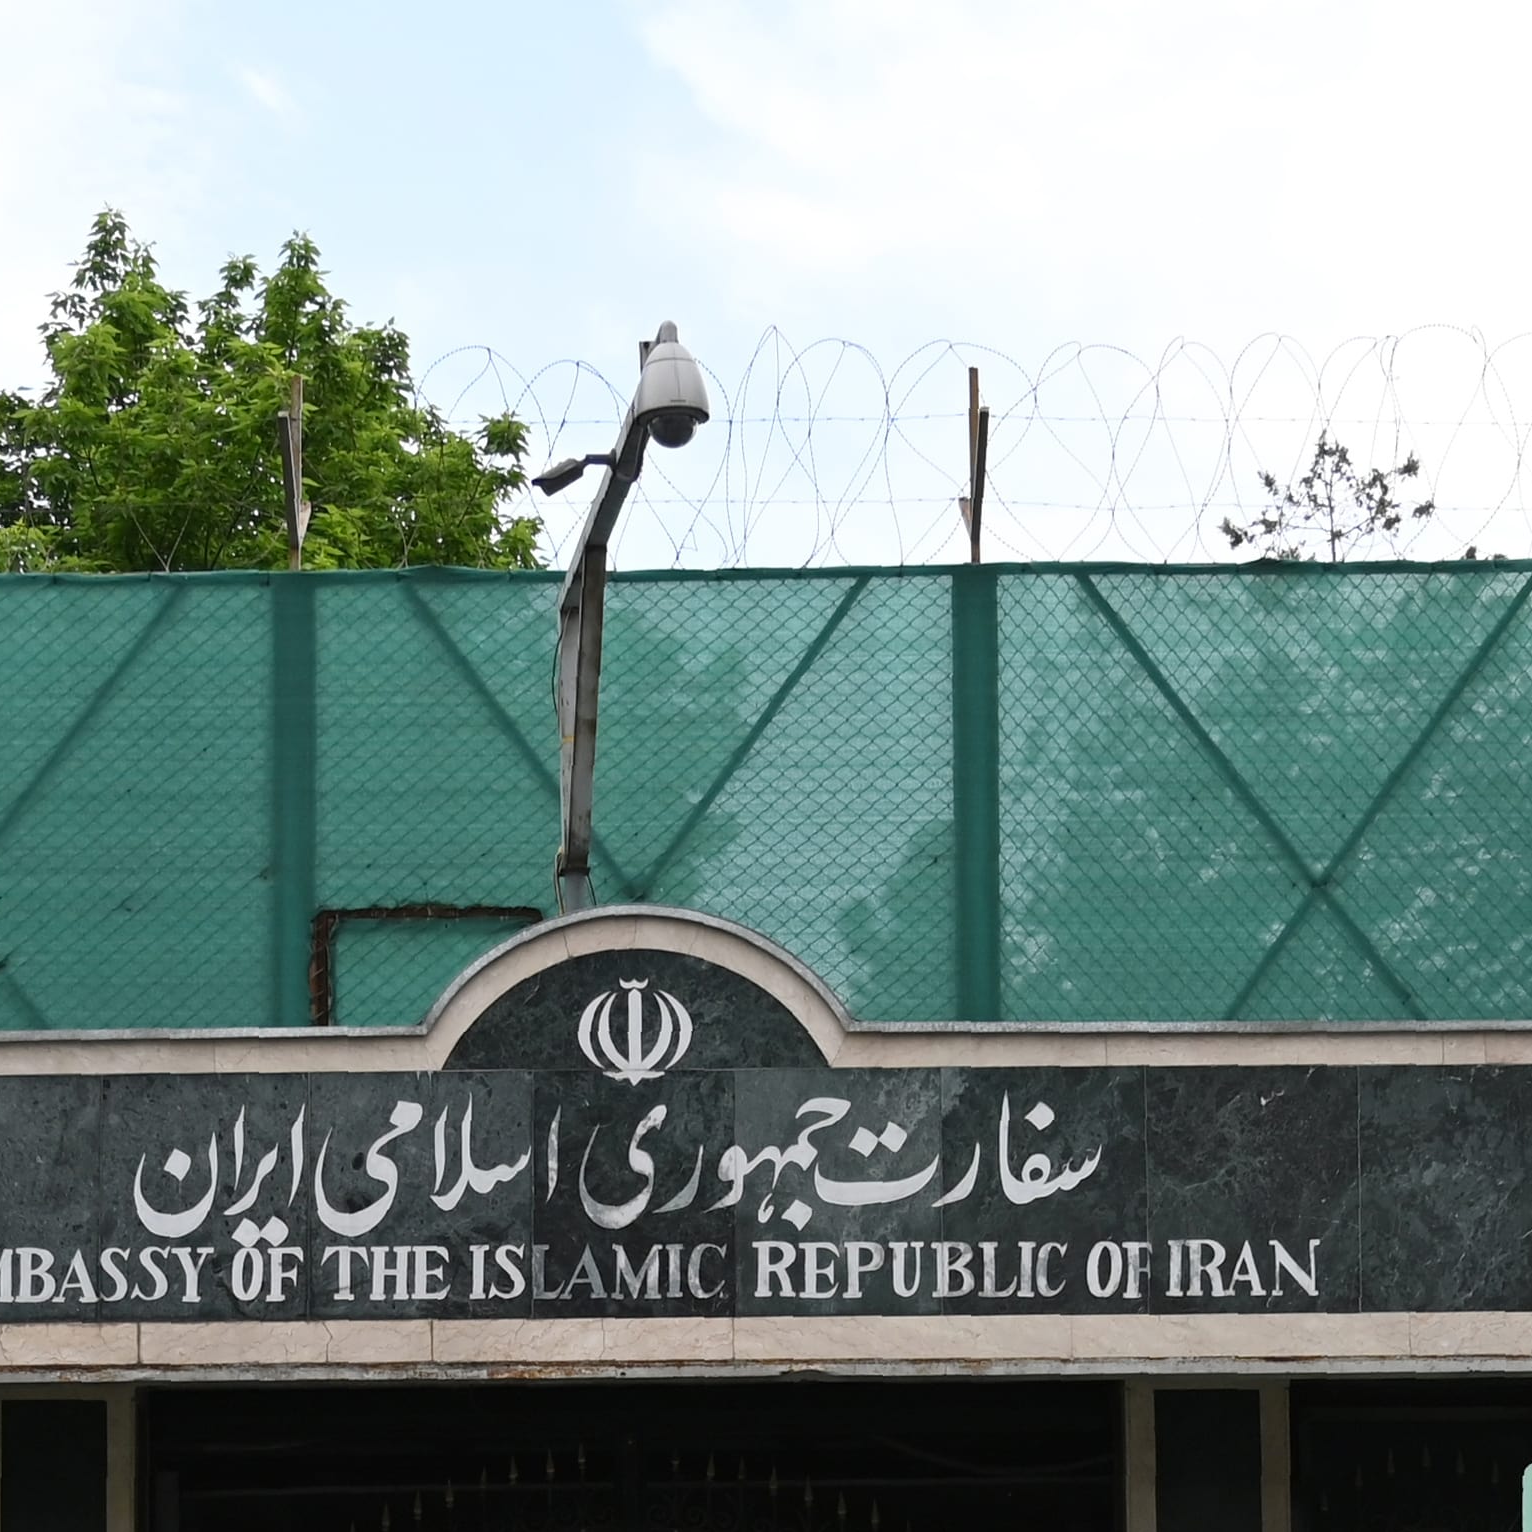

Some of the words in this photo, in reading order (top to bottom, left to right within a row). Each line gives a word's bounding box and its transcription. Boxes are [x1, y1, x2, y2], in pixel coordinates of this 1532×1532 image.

[133, 1103, 306, 1247] ایران
[314, 1091, 561, 1239] اسلامی
[579, 1096, 852, 1232] جمهوری
[814, 1090, 1102, 1208] سفارت
[231, 1245, 304, 1302] OF
[320, 1244, 451, 1302] THE
[469, 1242, 727, 1301] ISLAMIC
[751, 1240, 1068, 1300] REPUBLIC
[1086, 1240, 1153, 1300] OF
[1165, 1238, 1321, 1298] IRAN
